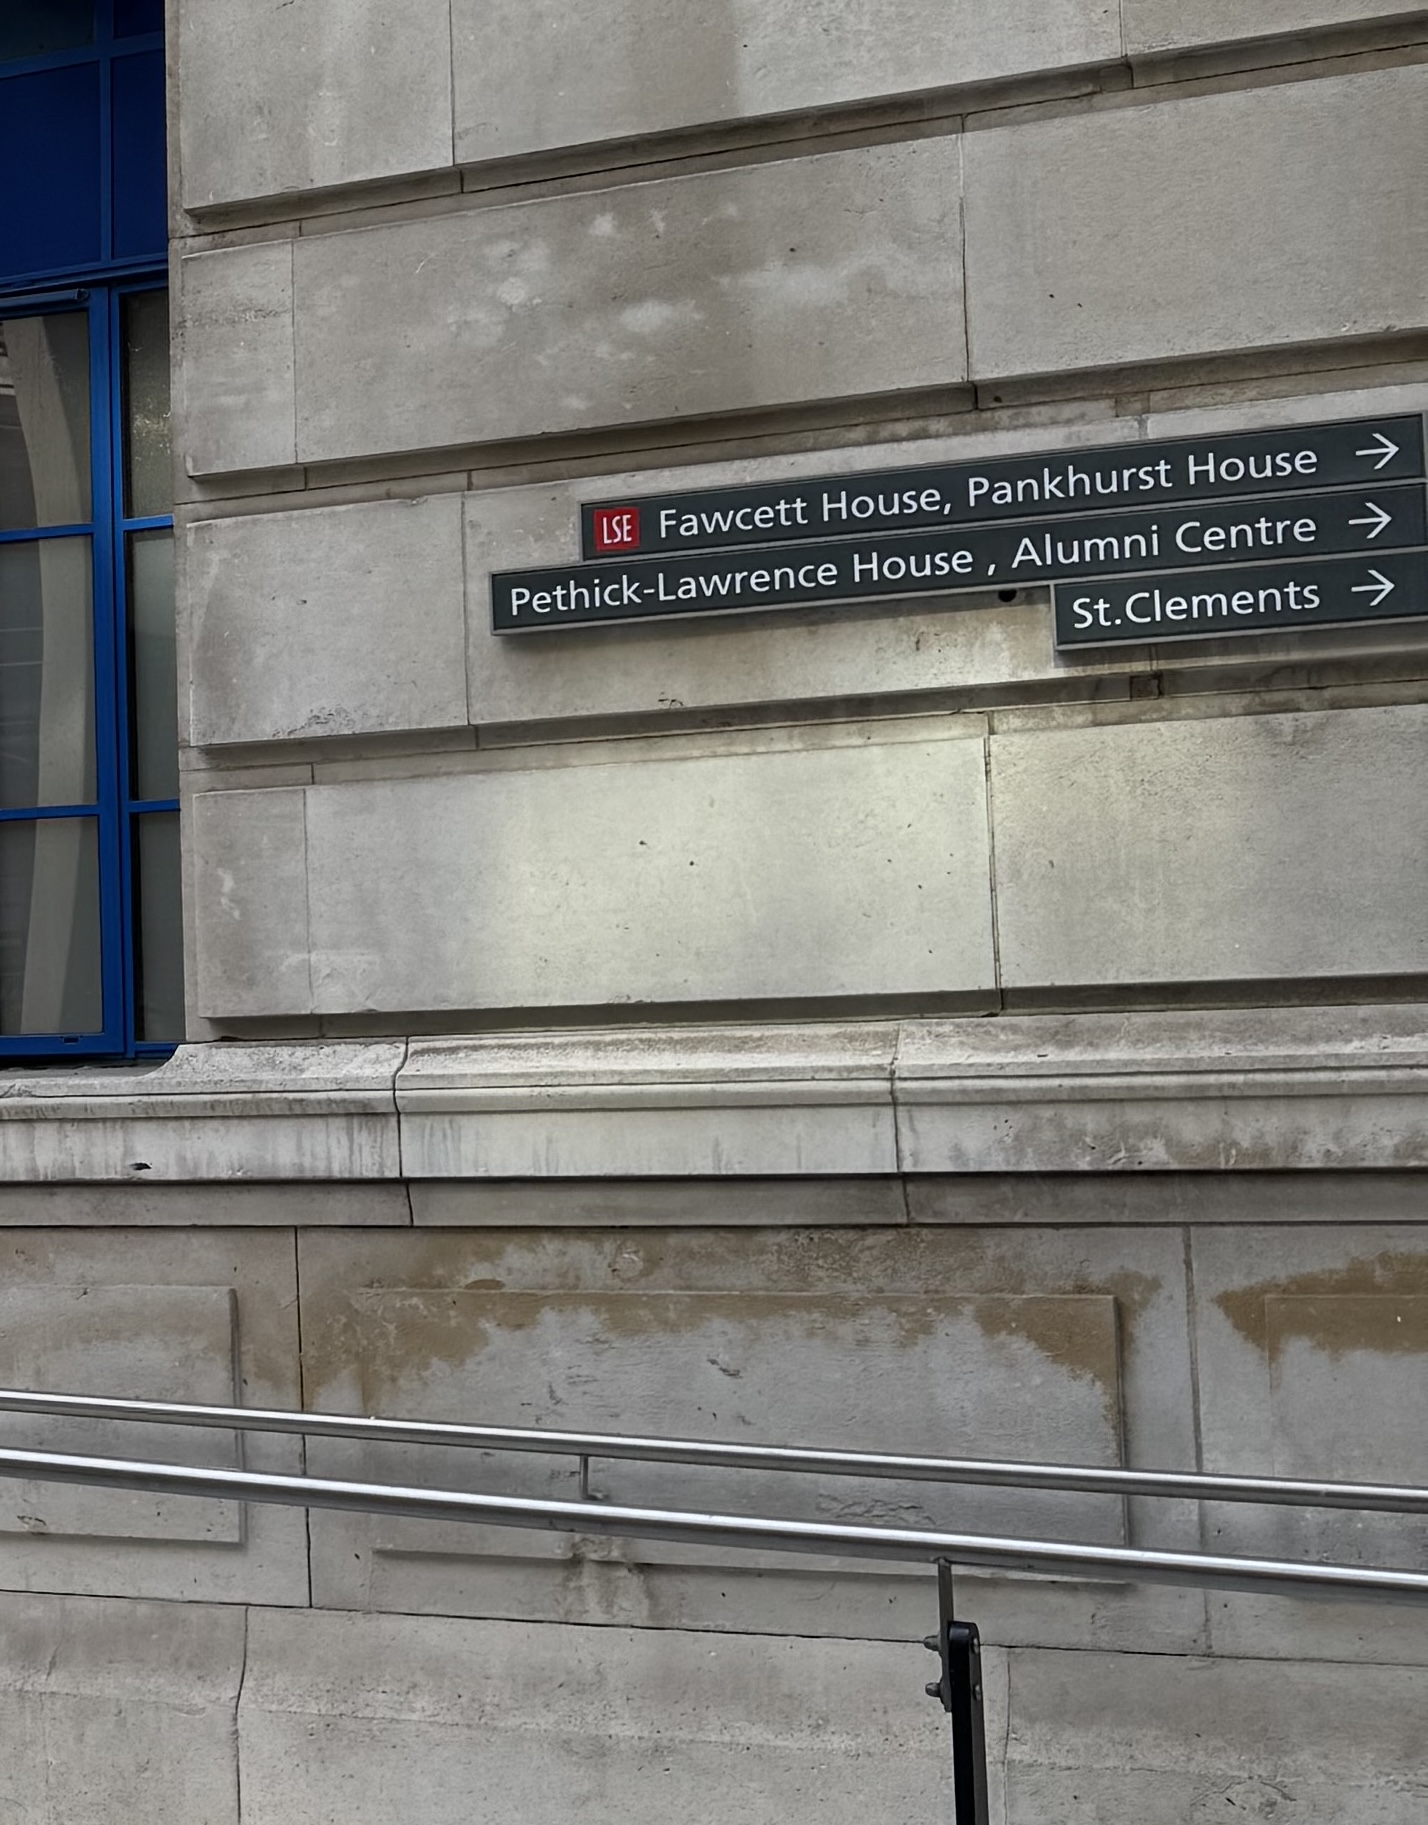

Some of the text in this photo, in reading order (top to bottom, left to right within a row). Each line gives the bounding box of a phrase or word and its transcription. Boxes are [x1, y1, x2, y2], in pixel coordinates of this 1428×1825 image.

[602, 448, 1319, 545] LSE Fawcett House, Pankhurst House
[510, 562, 838, 617] Pethick-Lawrence
[852, 549, 975, 583] House
[1011, 524, 1160, 569] Alumni
[1175, 516, 1317, 554] Centre
[1072, 581, 1321, 629] St.Clements
